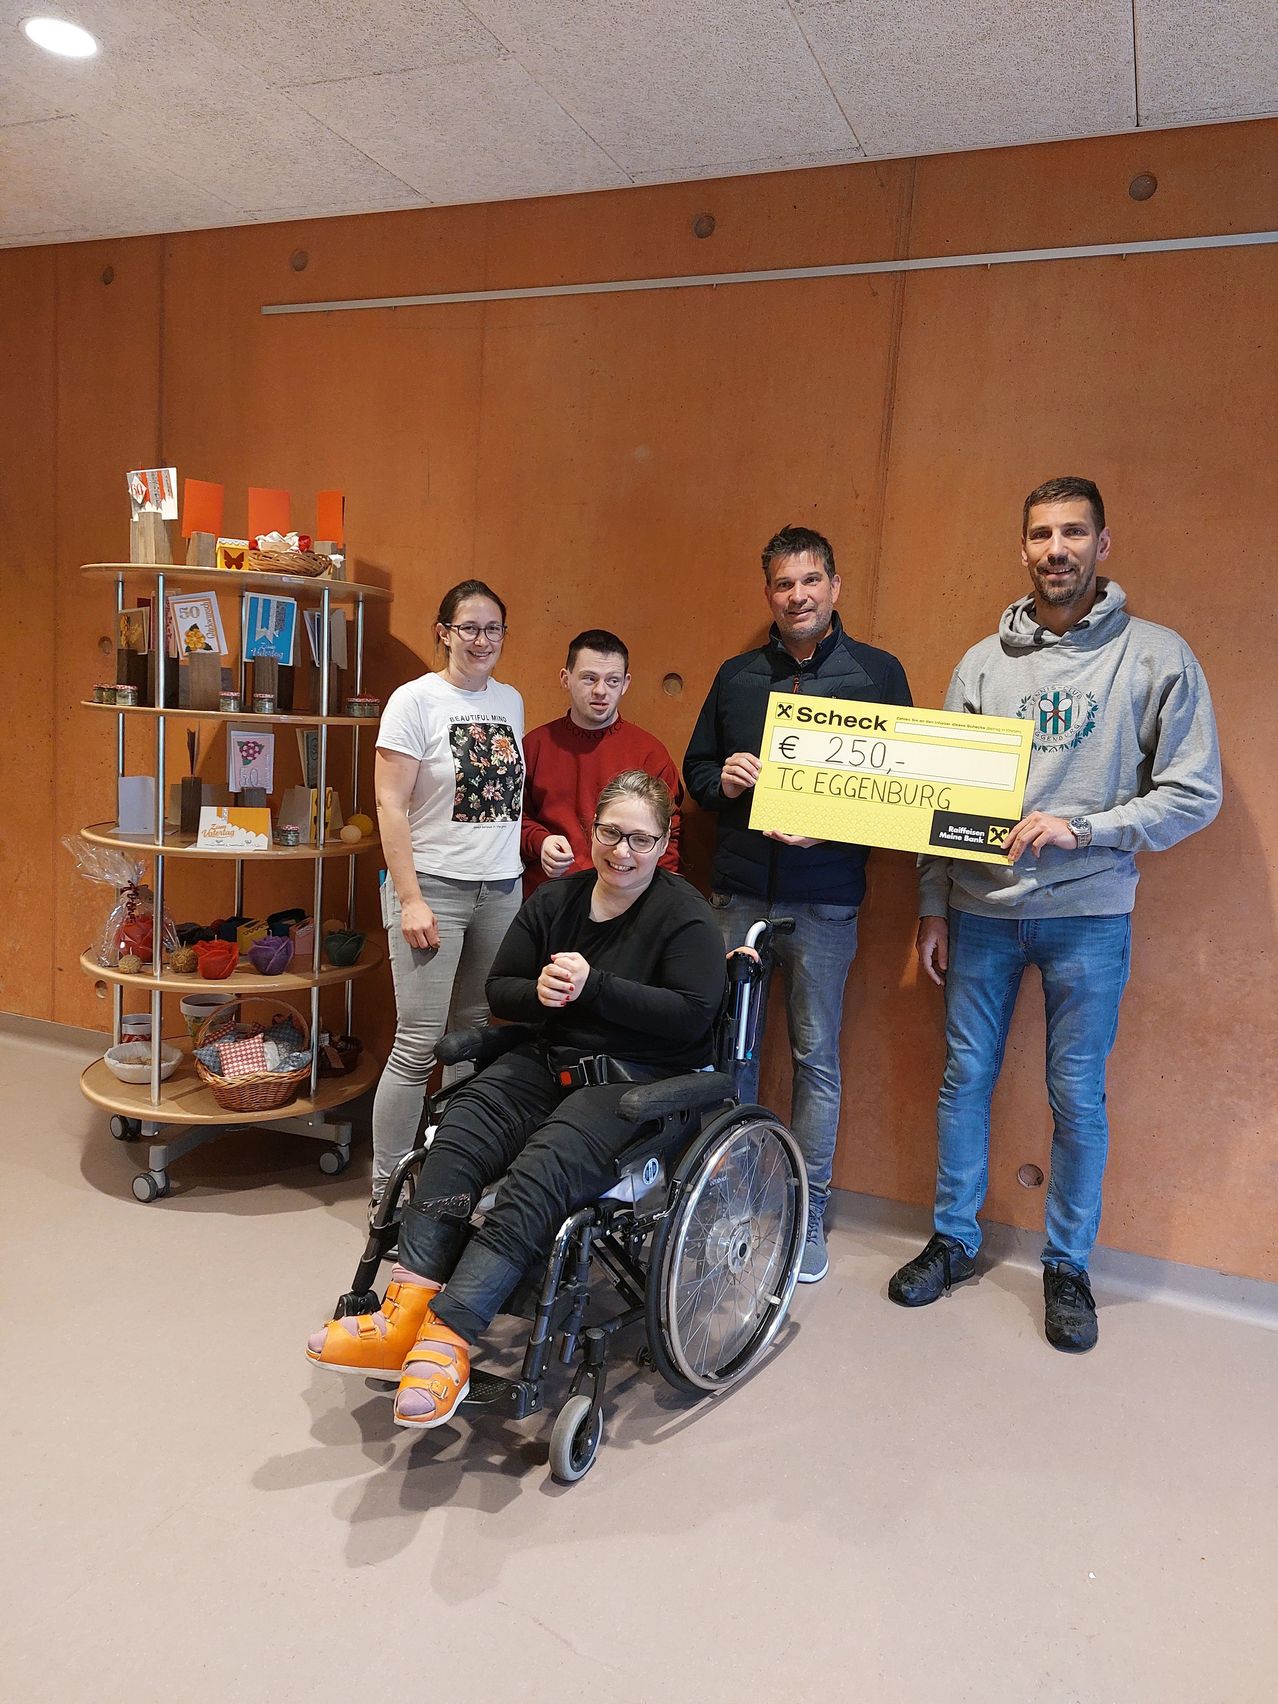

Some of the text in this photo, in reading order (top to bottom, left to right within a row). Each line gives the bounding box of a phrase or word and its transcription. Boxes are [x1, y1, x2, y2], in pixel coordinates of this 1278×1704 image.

[179, 606, 200, 620] 50
[449, 714, 507, 722] BEAUTIFUL MIND
[796, 706, 888, 732] Scheck
[778, 735, 800, 760] €
[777, 766, 952, 811] TC EGGENBURG
[201, 829, 236, 838] Vatertag
[948, 826, 985, 836] Raiffeisen
[939, 832, 984, 844] Meine Bank
